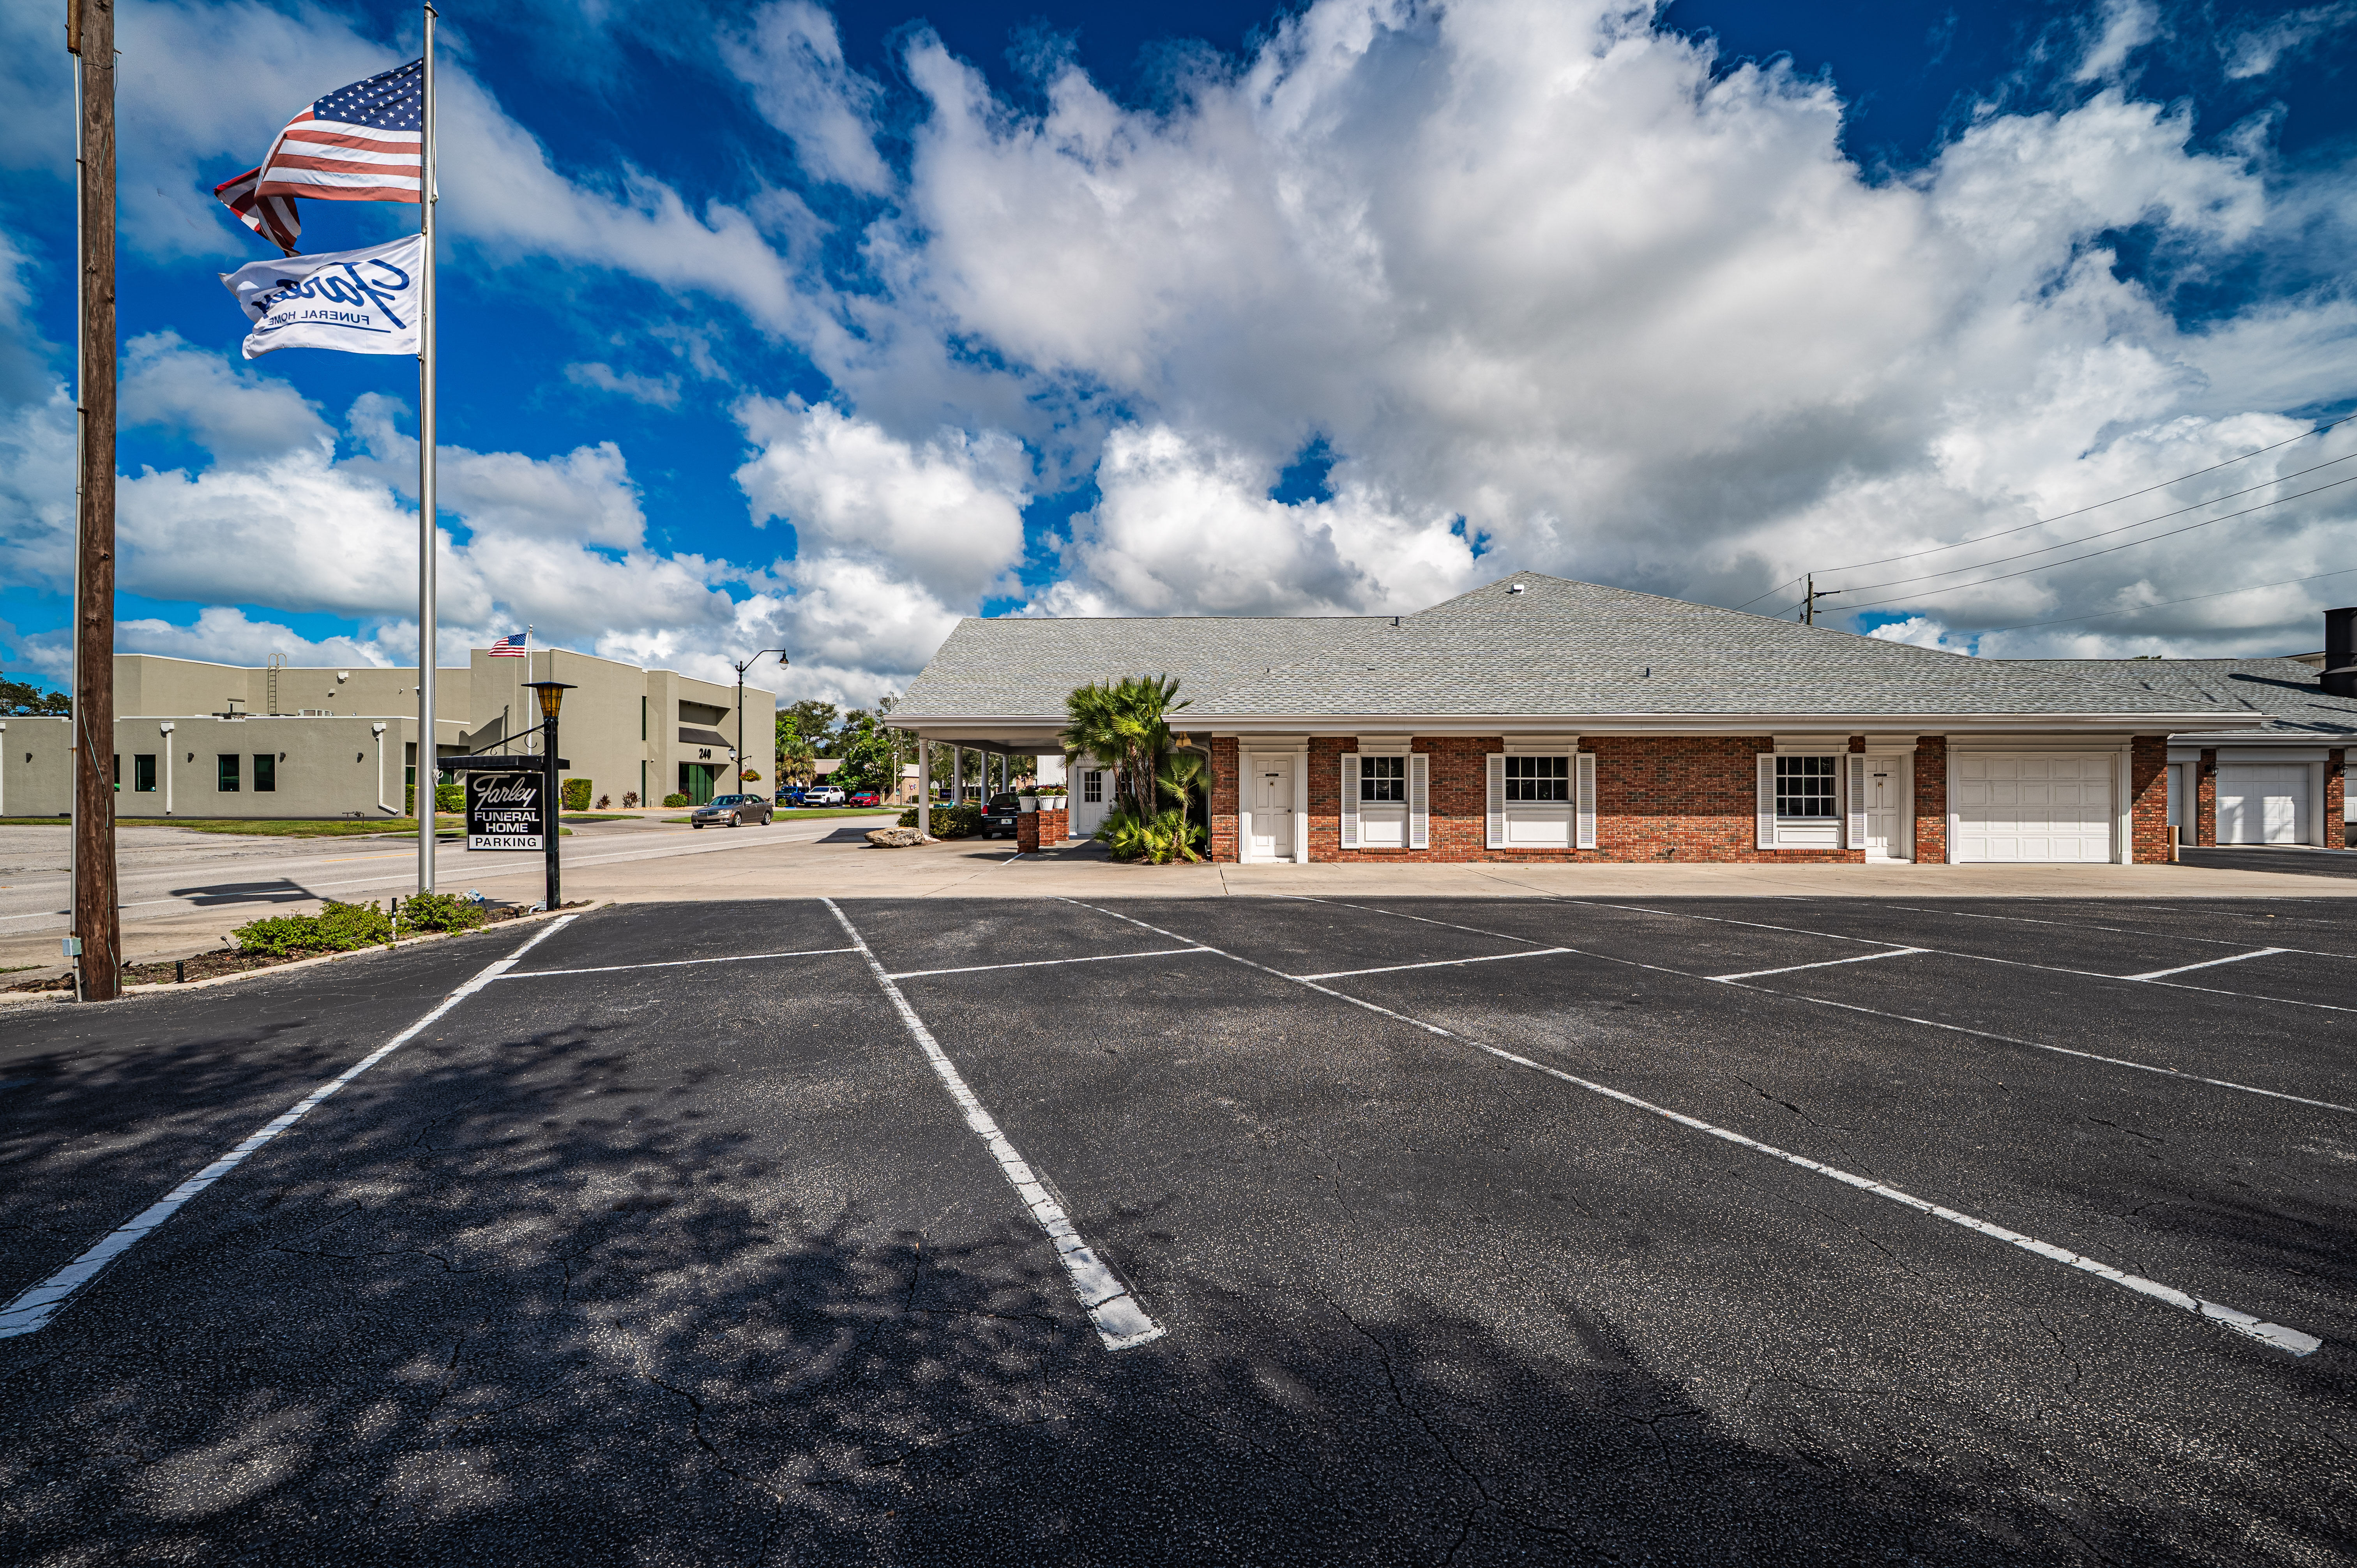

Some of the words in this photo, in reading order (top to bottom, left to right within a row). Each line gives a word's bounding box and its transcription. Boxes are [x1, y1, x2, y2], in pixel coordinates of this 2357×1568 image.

[699, 748, 711, 760] 240
[473, 774, 537, 810] Farley
[474, 812, 540, 821] FUNERAL
[486, 823, 528, 832] HOME
[475, 837, 537, 847] PARKING
